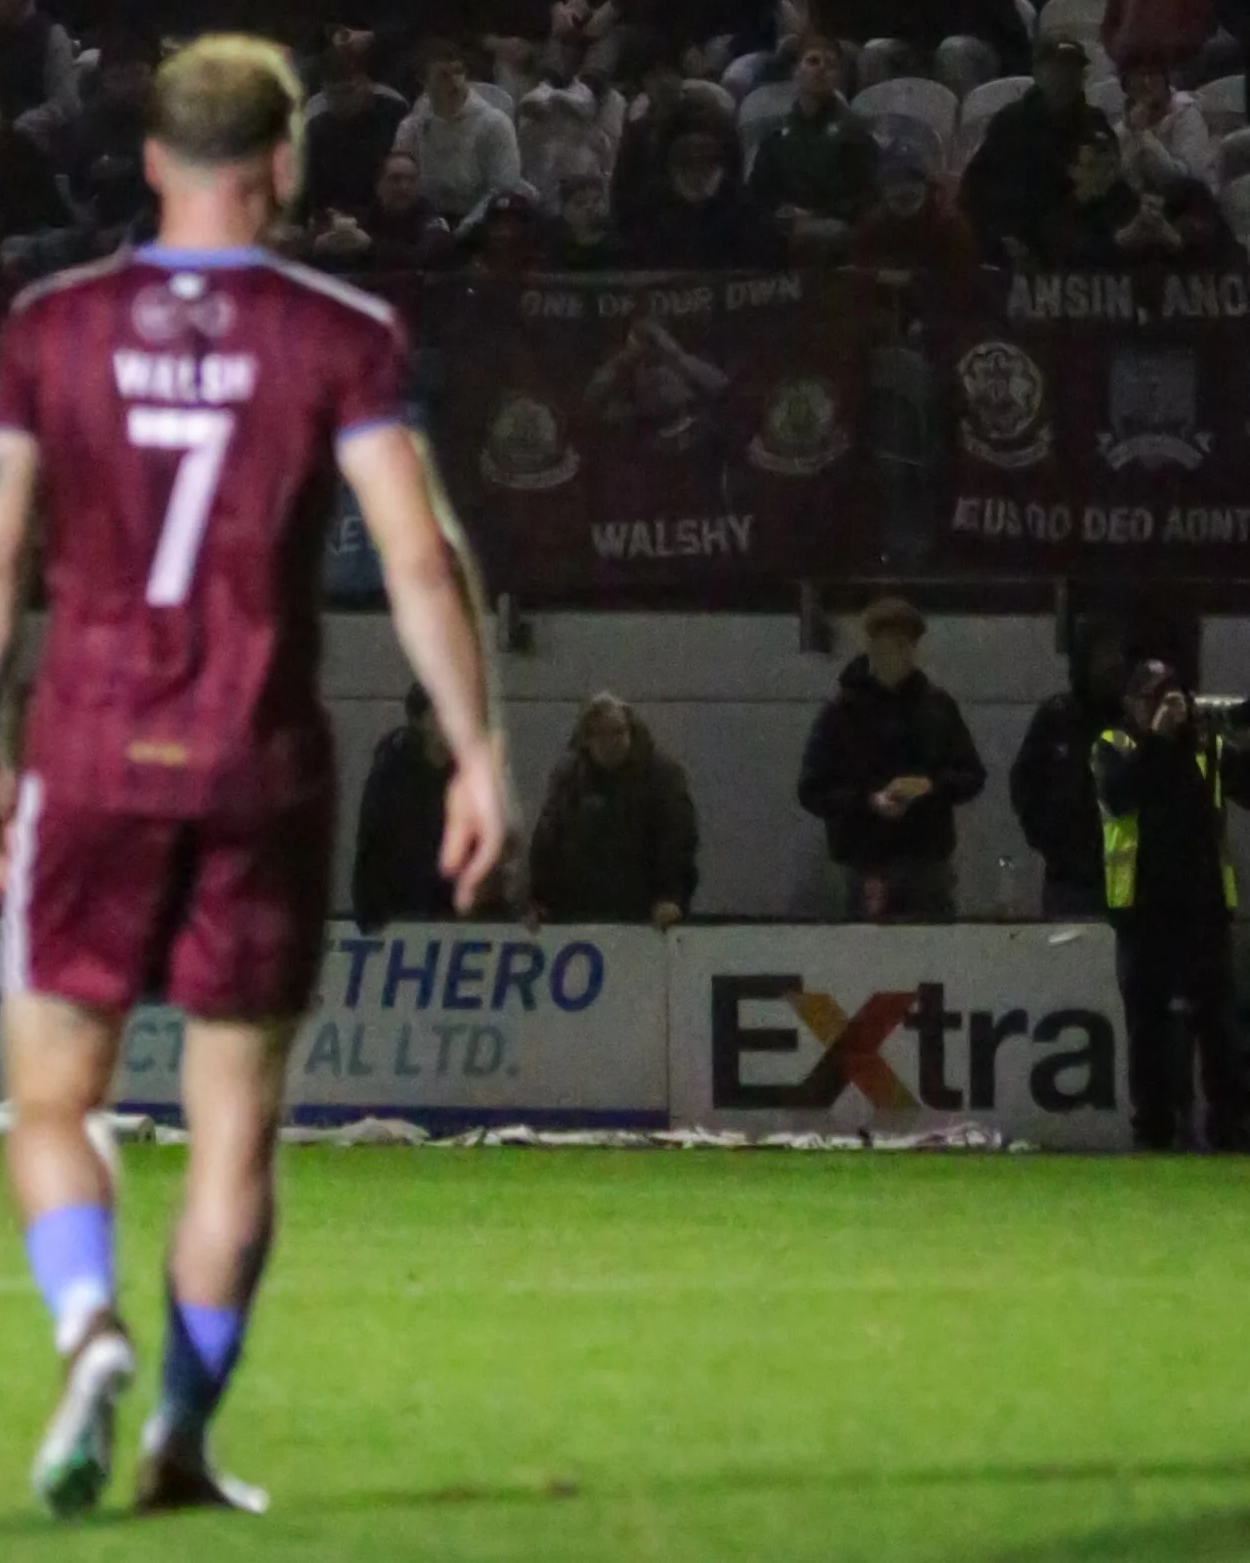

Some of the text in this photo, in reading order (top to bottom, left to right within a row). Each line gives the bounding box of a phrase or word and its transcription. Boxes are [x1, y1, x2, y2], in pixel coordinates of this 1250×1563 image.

[126, 406, 236, 608] 7
[589, 513, 755, 559] WALSHY
[712, 974, 1117, 1113] Extra
